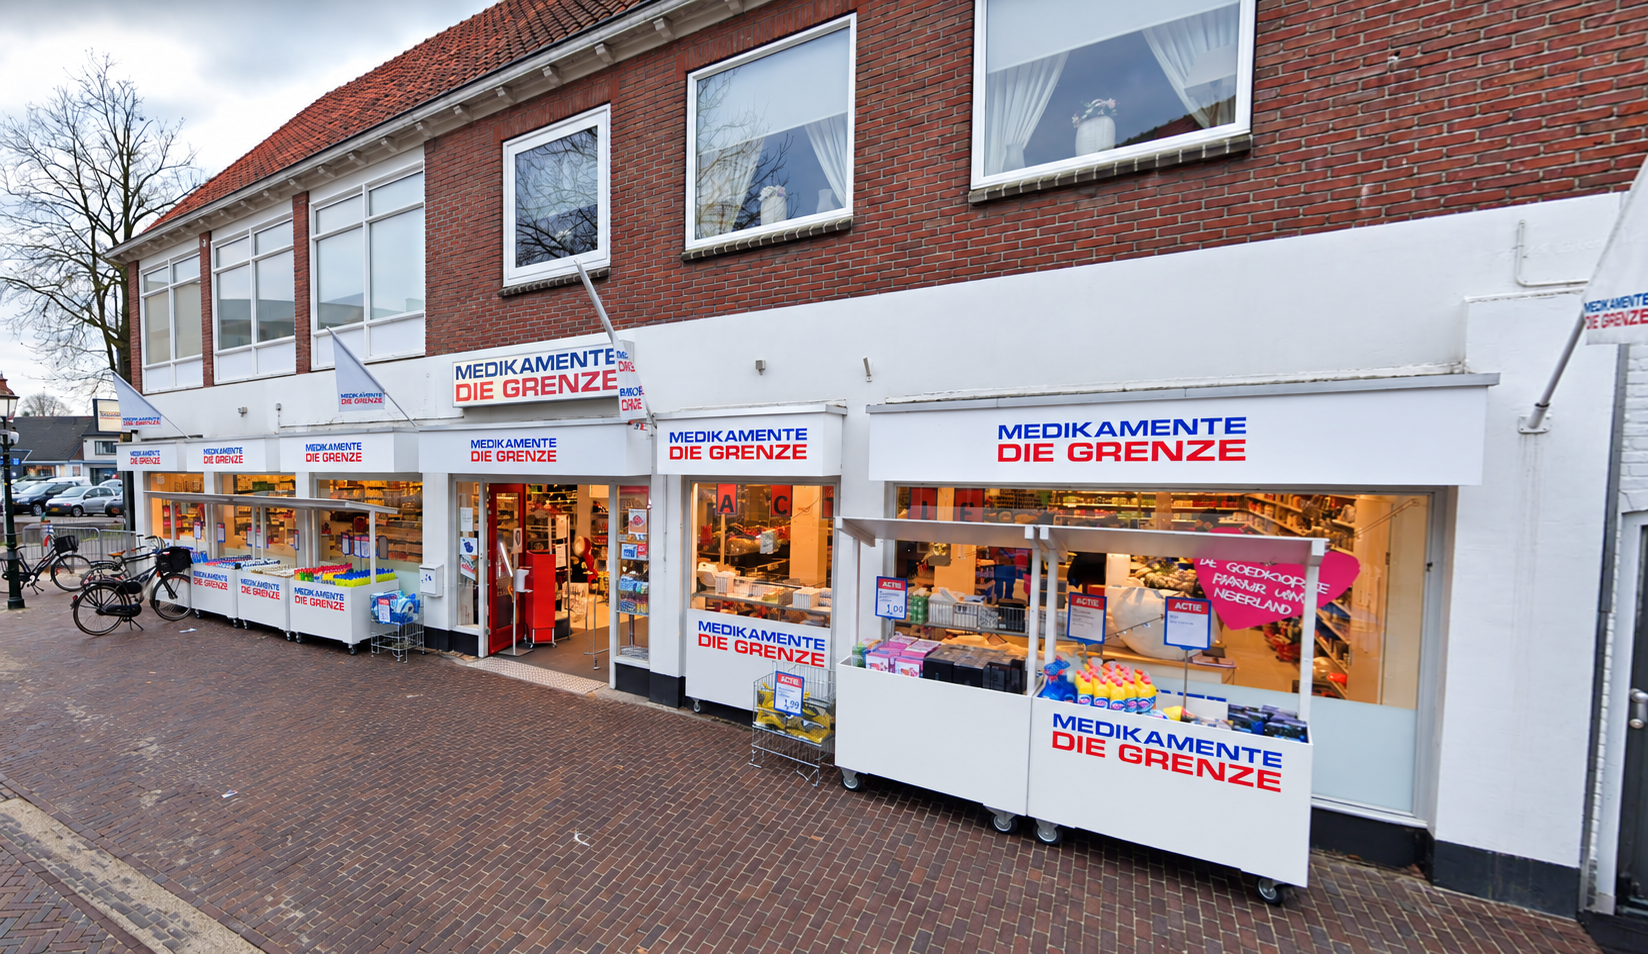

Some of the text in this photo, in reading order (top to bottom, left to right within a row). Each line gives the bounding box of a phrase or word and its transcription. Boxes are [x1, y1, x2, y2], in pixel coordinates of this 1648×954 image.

[455, 348, 615, 380] MEDIKAMENTE
[455, 381, 494, 402] DIE
[502, 369, 618, 398] GRENZE
[669, 428, 807, 443] MEDIKAMENTE
[998, 416, 1247, 440] MEDIKAMENTE
[306, 442, 362, 452] MEDIKAMENTE
[471, 438, 557, 448] MEDIKAMENTE
[669, 444, 807, 460] DIE GRENZE
[997, 439, 1246, 462] DIE GRENZE
[306, 452, 362, 462] DIE GRENZE
[471, 450, 557, 462] DIE GRENZE
[1076, 597, 1099, 607] ACTIE
[1174, 602, 1202, 612] ACTIE
[698, 620, 825, 651] MEDIKAMENTE
[698, 633, 825, 667] DIE GRENZE
[1053, 713, 1282, 768] MEDIKAMENTE
[1052, 730, 1281, 793] DIE GRENZE
